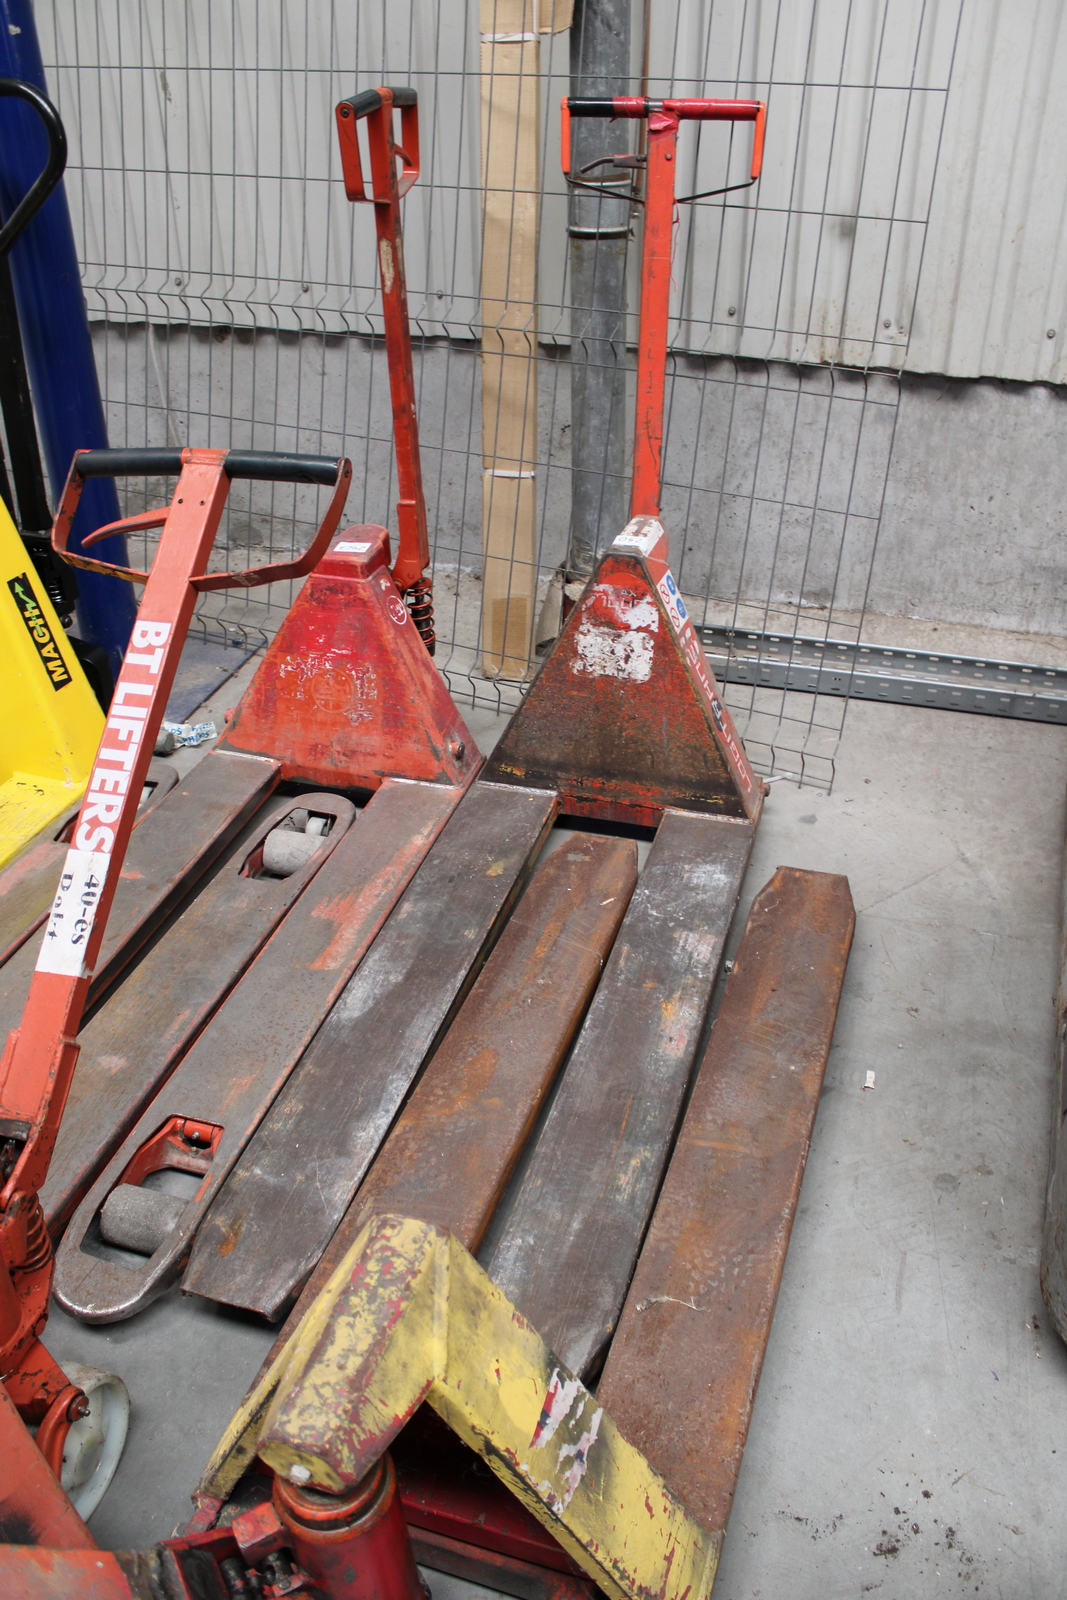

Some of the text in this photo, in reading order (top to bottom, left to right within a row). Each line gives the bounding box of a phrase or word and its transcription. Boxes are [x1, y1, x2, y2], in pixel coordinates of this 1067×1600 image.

[23, 608, 69, 682] MACH
[75, 620, 172, 854] BT LIFTERS
[70, 874, 100, 946] 40-es
